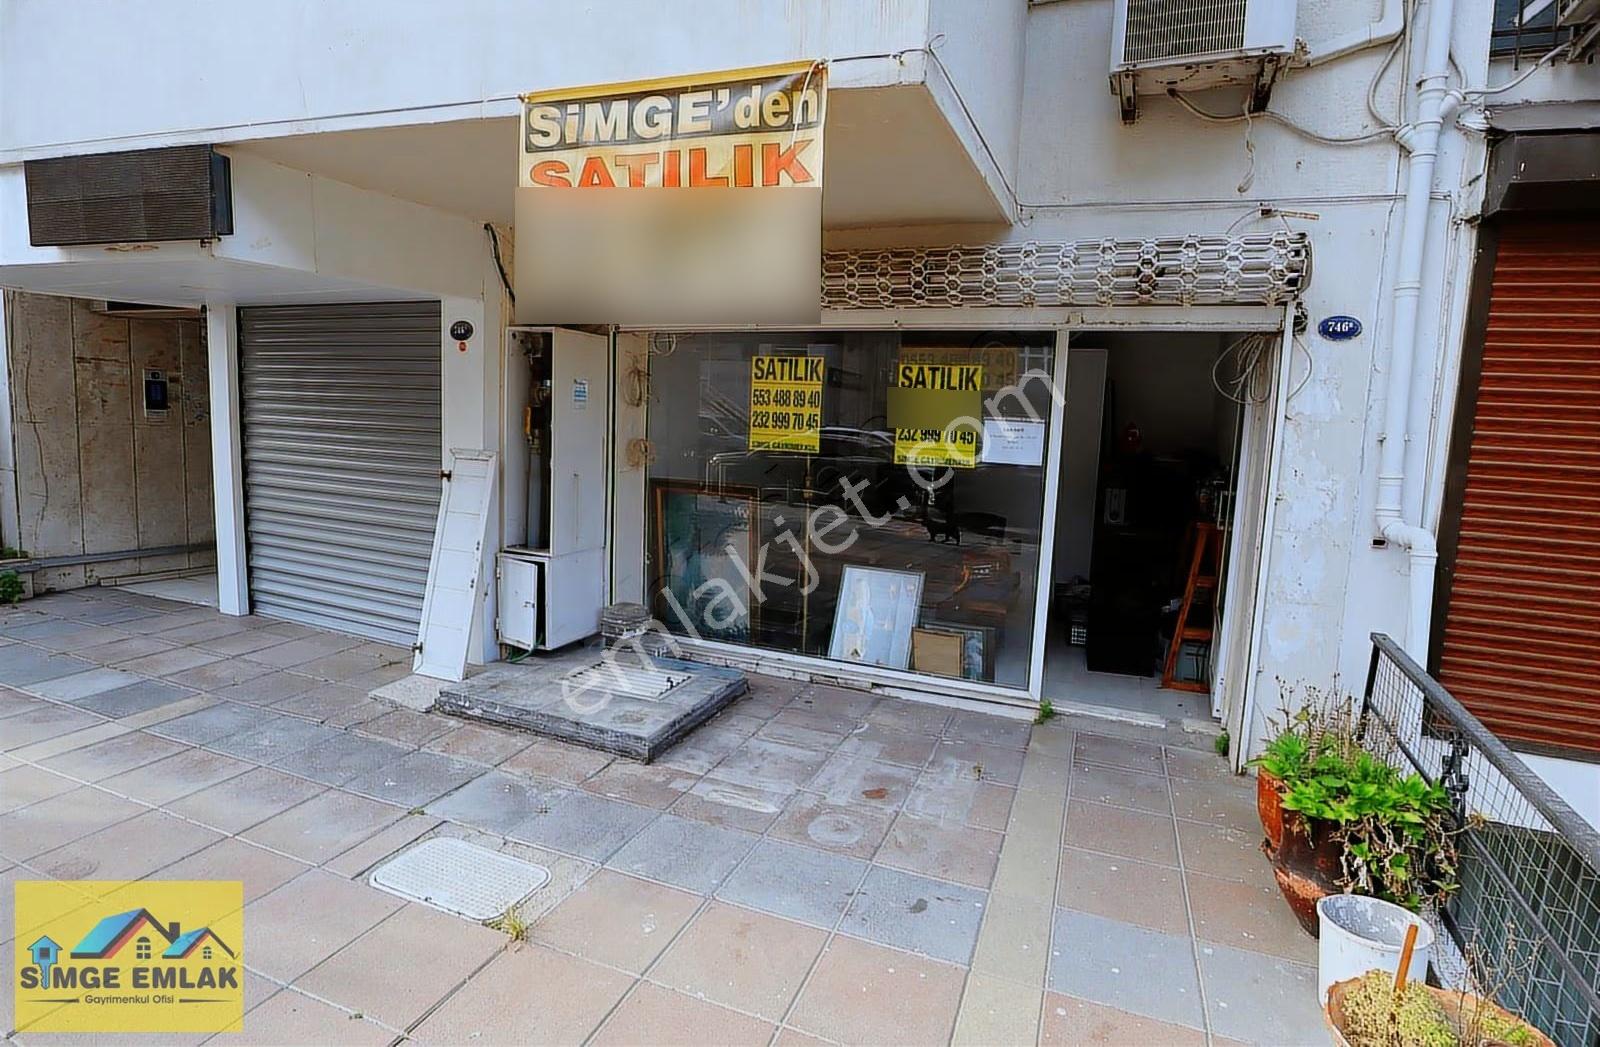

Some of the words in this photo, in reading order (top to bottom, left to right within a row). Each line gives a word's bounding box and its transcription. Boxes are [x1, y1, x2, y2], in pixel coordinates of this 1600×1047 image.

[529, 138, 815, 187] SATILIK
[754, 358, 822, 382] SATILIK
[900, 366, 979, 391] SATILIK
[753, 388, 771, 406] 553
[772, 389, 791, 407] 488
[793, 390, 805, 408] 89
[807, 391, 820, 409] 40
[752, 410, 770, 428] 232
[771, 412, 790, 430] 999
[792, 413, 804, 430] 70
[806, 413, 819, 430] 45
